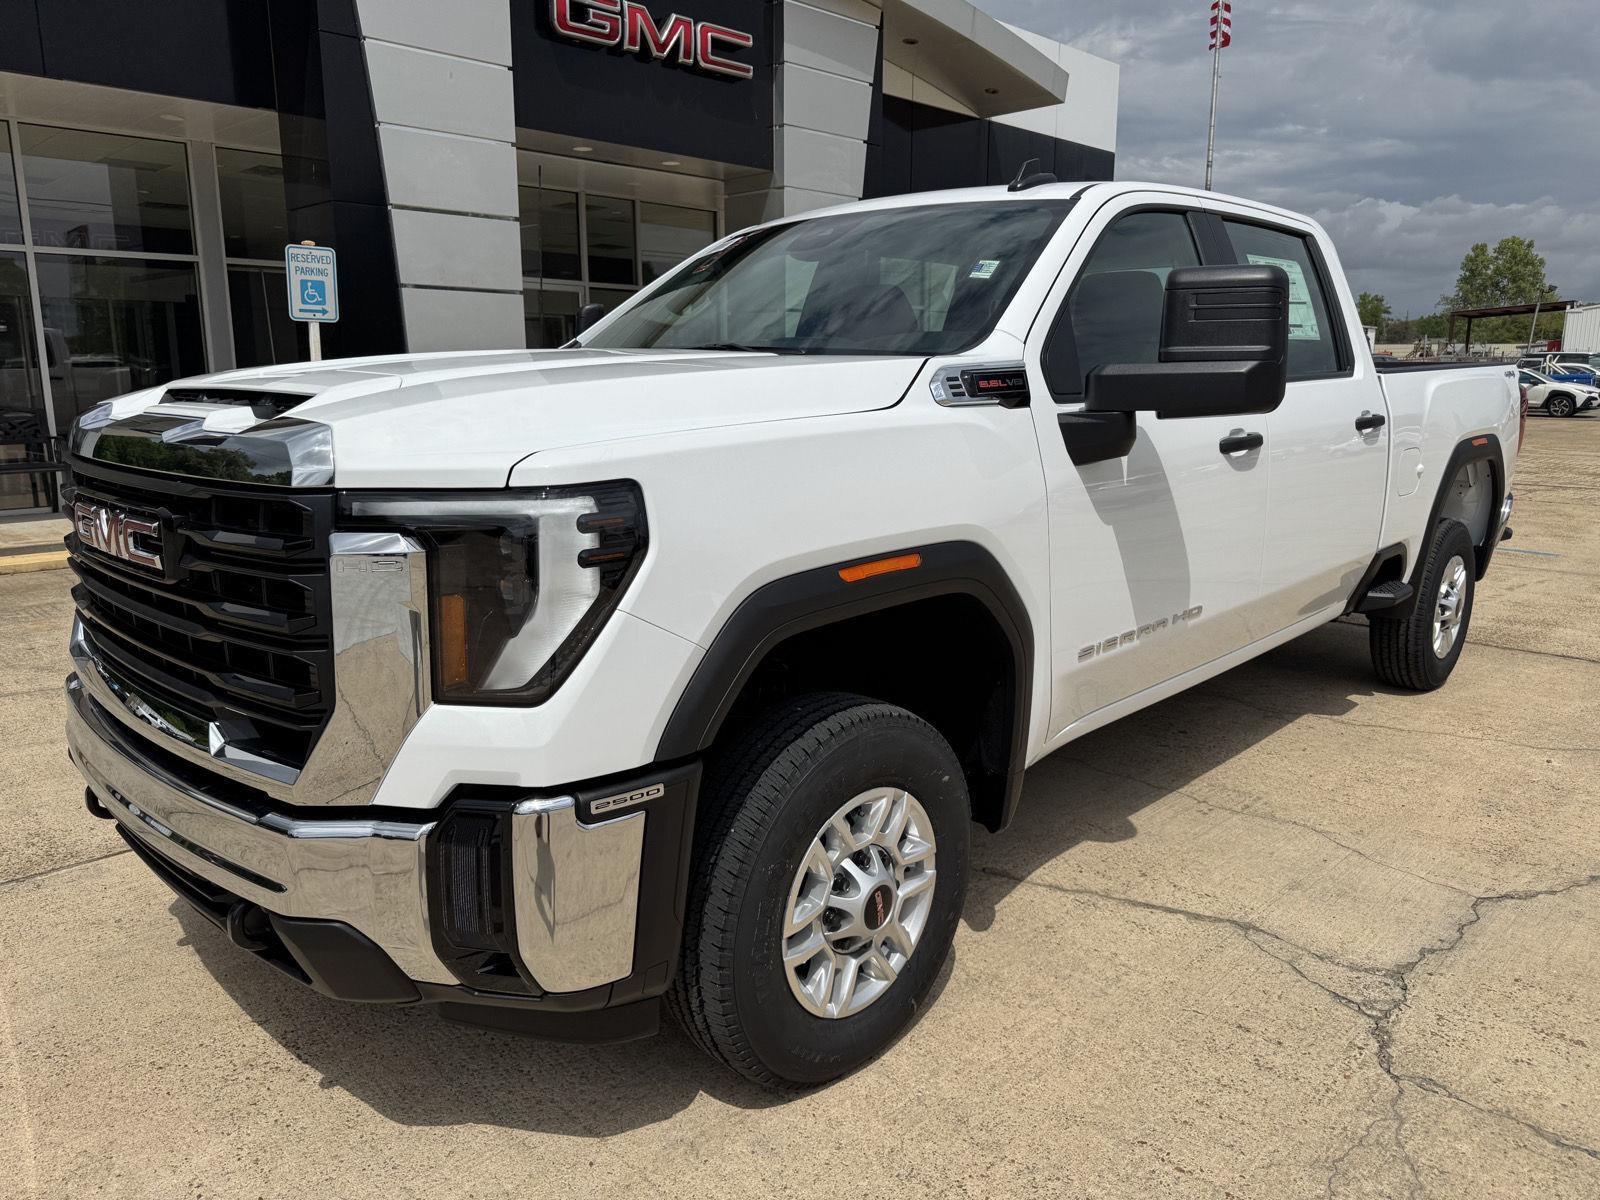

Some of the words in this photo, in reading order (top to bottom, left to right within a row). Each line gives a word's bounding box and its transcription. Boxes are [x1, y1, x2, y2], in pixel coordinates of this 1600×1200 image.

[553, 0, 753, 79] GMC
[290, 252, 332, 265] RESERVED
[294, 266, 329, 277] PARKING
[74, 502, 163, 571] GMC
[1078, 617, 1169, 663] SIERRA
[1172, 604, 1203, 625] HD
[594, 787, 661, 810] 2500
